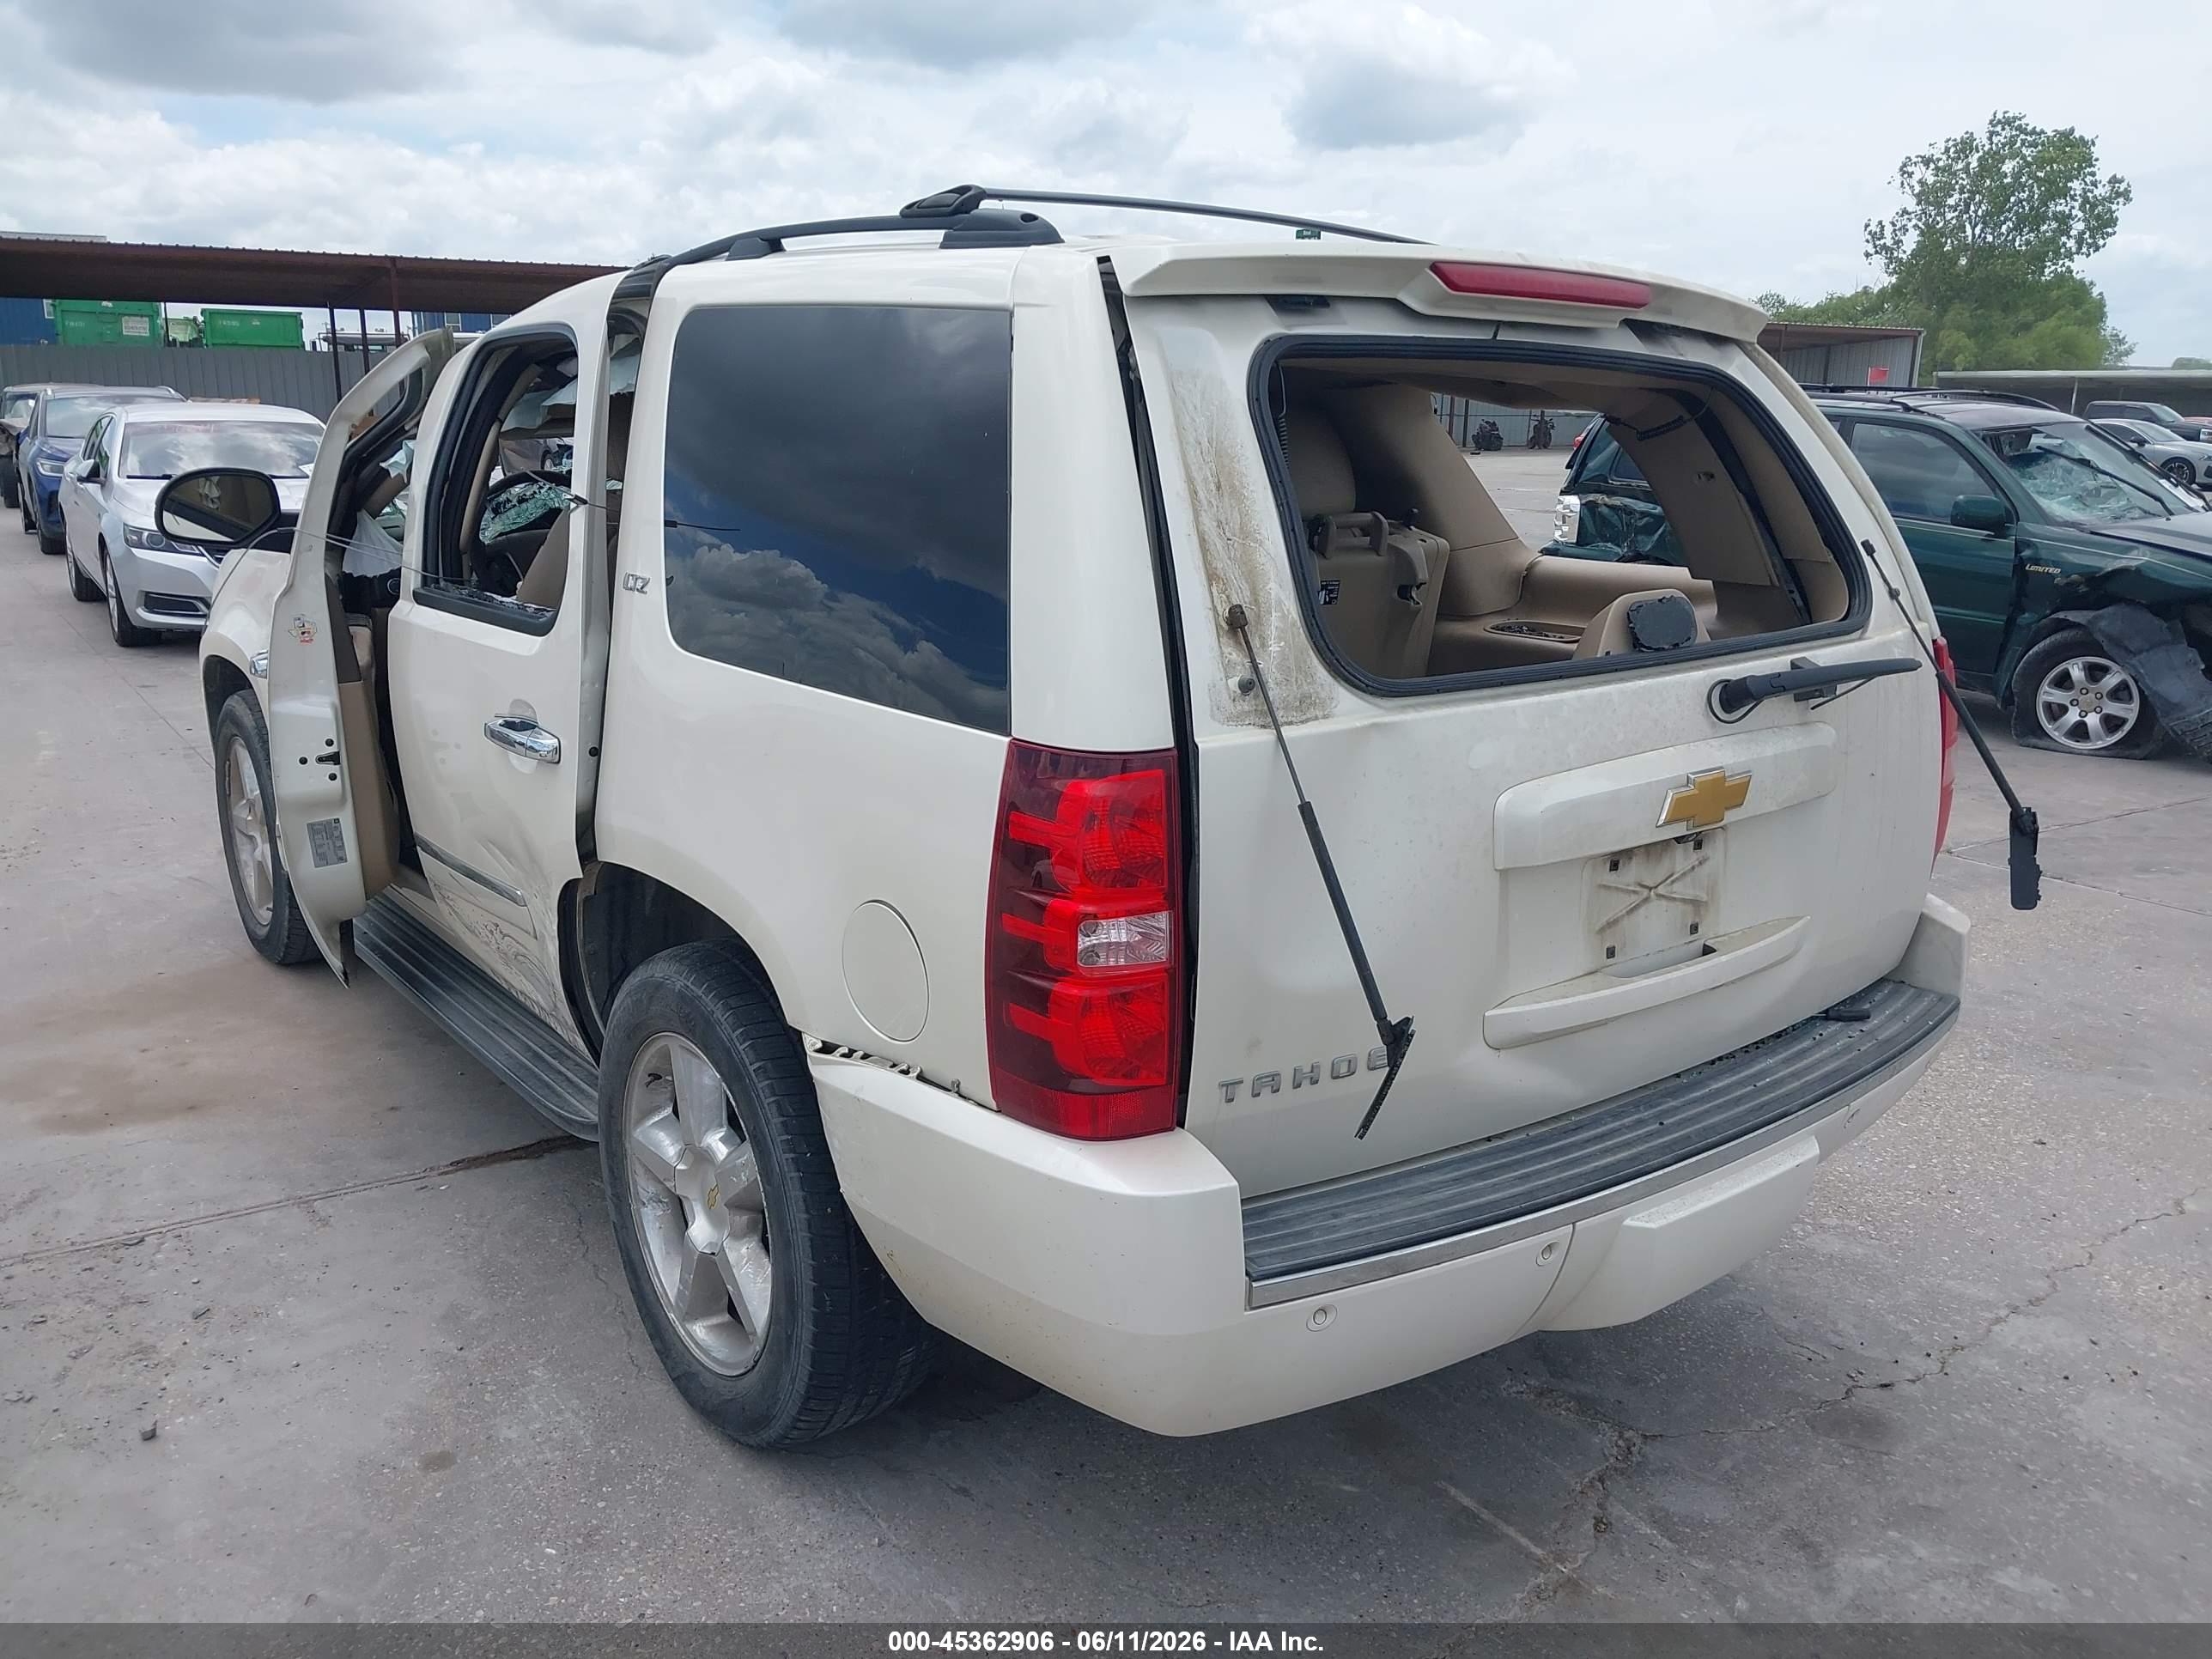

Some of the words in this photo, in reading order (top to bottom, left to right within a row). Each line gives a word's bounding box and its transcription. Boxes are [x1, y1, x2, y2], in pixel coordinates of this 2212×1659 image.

[2025, 563, 2062, 574] LIMITED
[623, 572, 651, 594] LTZ
[1218, 1046, 1389, 1103] TAHOE
